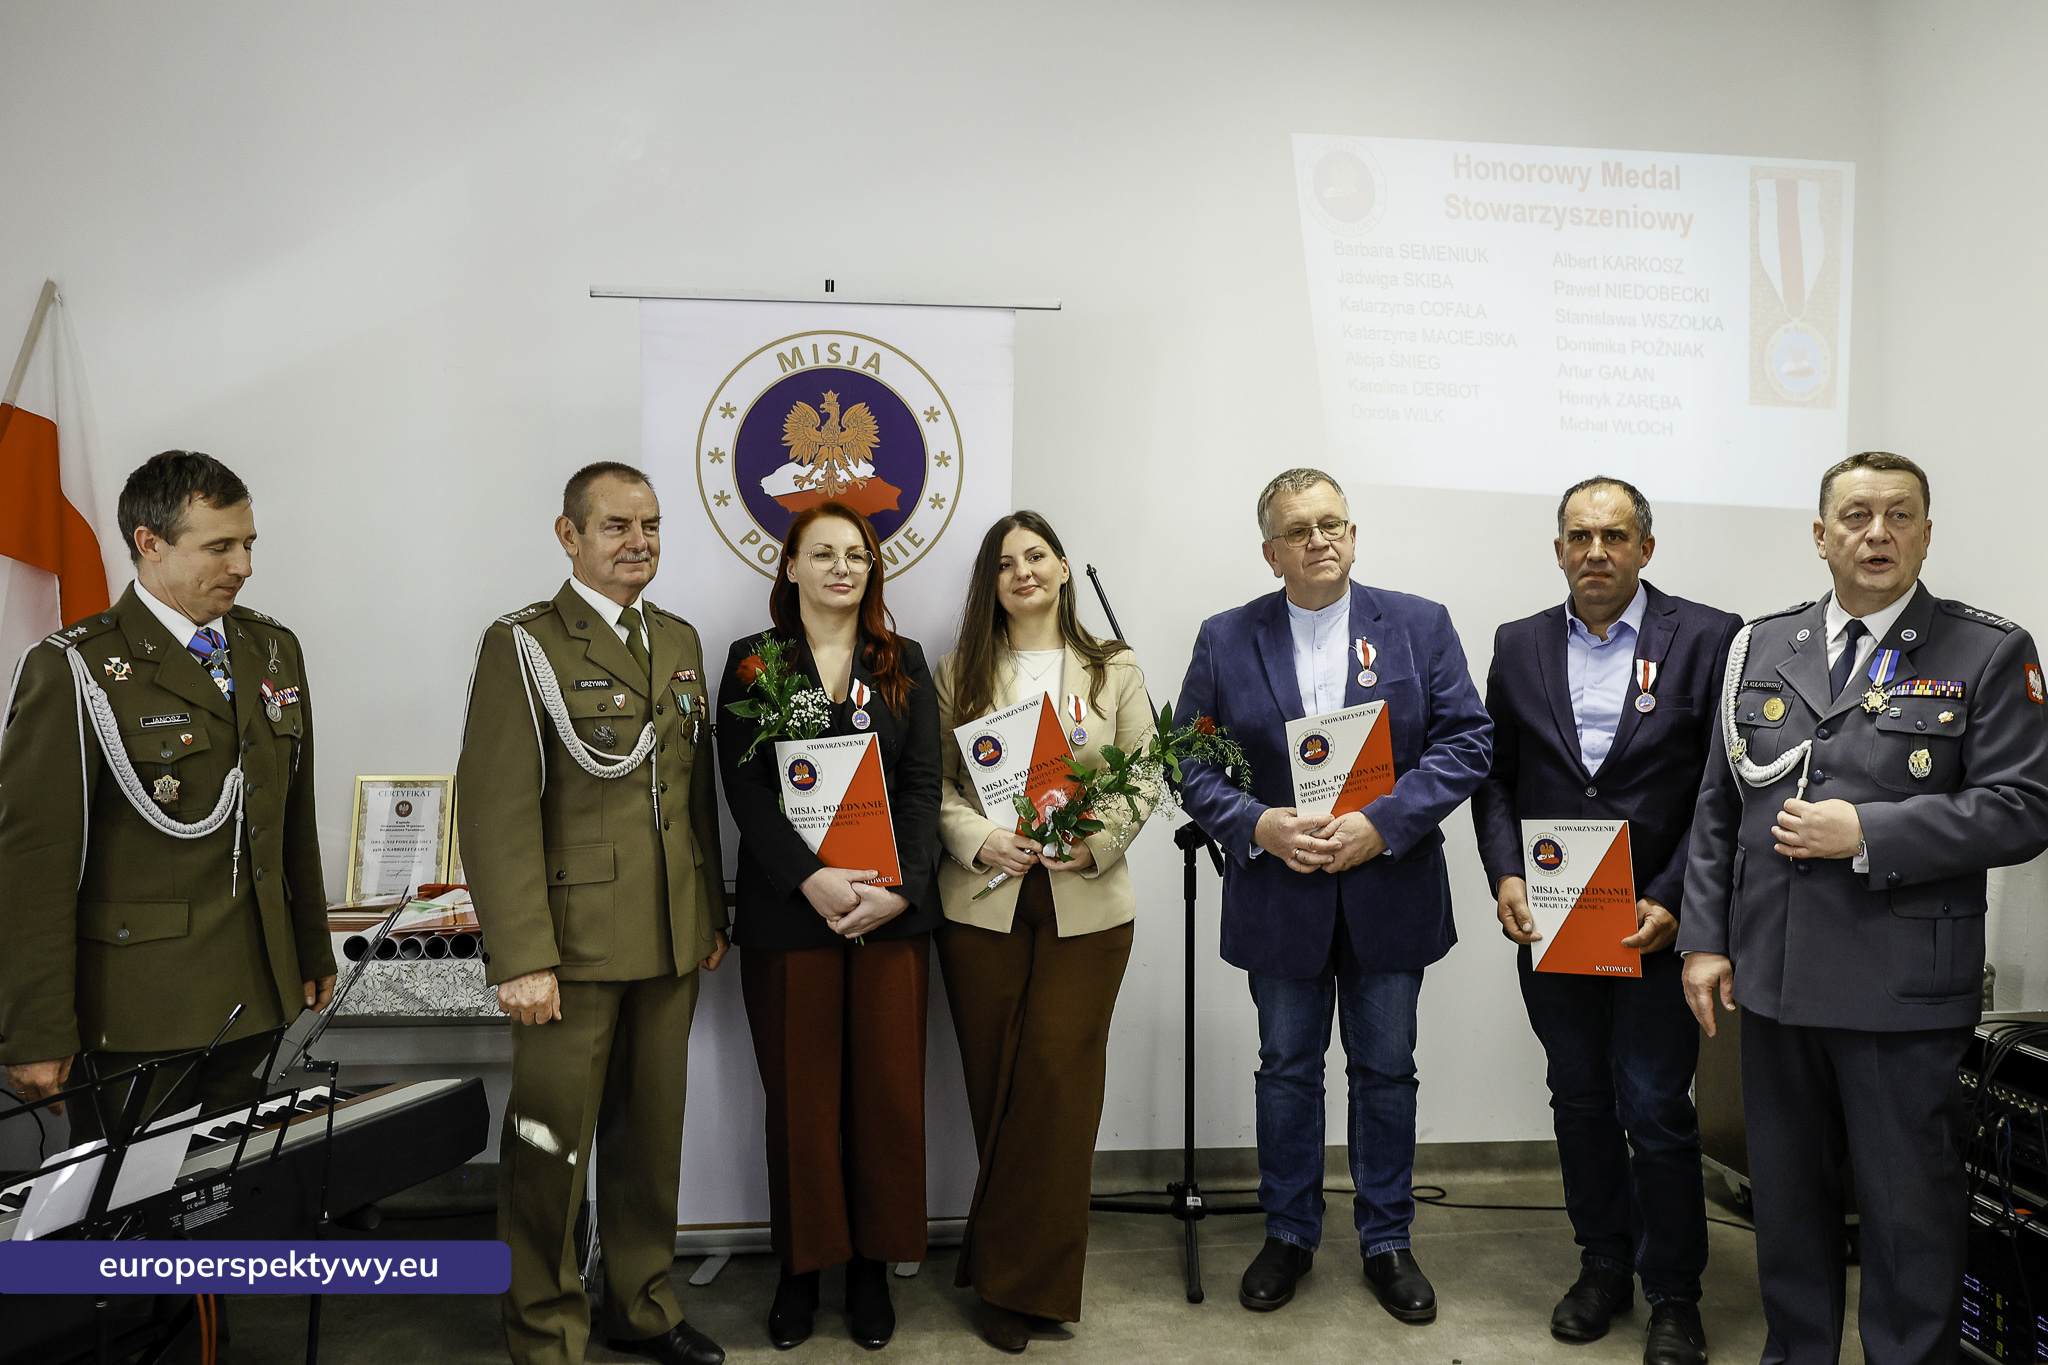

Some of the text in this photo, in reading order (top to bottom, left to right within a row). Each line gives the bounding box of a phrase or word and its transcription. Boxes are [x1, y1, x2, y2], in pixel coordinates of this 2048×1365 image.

[1452, 153, 1681, 193] Honorowy Medal
[1443, 193, 1695, 239] Stowarzyszeniowy
[1333, 240, 1490, 264] Barbara SEMENIUK
[1552, 252, 1685, 274] Albert KARKOSZ
[1336, 268, 1455, 290] Jadwiga SKIBA
[1605, 283, 1710, 303] NIEDOBECKI
[1339, 296, 1488, 319] Katarzyna COFAŁA
[1555, 308, 1725, 332] Stanisława WSZOŁKA
[1342, 323, 1518, 349] Katarzyna MACIEJSKA
[1556, 335, 1626, 354] Dominika
[776, 342, 881, 375] MISJA
[1345, 349, 1441, 371] Alicja ŚNIEG
[1557, 362, 1594, 379] Artur
[1348, 377, 1481, 400] Karolina DERBOT
[1559, 389, 1683, 412] Henryk ZARĘBA
[1351, 403, 1445, 423] Dorota WILK
[1612, 418, 1674, 437] WŁOCH
[580, 680, 609, 688] GRZYWNA
[151, 715, 181, 724] JANOSZ
[985, 699, 1041, 727] STOWARZYSZENIE
[1320, 708, 1378, 726] STOWARZYSZENIE
[806, 740, 867, 751] STOWARZYSZENIE
[981, 776, 1009, 794] MISJA
[1014, 752, 1071, 781] POJEDNANIE
[1021, 763, 1071, 787] PATRIOTYCZNYC
[1299, 778, 1327, 791] MISJA
[1333, 763, 1391, 783] POJEDNANIE
[1299, 785, 1336, 798] ŚRODOWISK
[1307, 795, 1327, 803] KRAJU
[790, 806, 816, 816] MISJA
[823, 800, 885, 814] POJEDNANIE
[1531, 885, 1559, 895] MISJA
[1567, 887, 1631, 896] POJEDNANIE
[1531, 894, 1568, 902] ŚRODOWISK
[1595, 965, 1634, 973] KATOWICE
